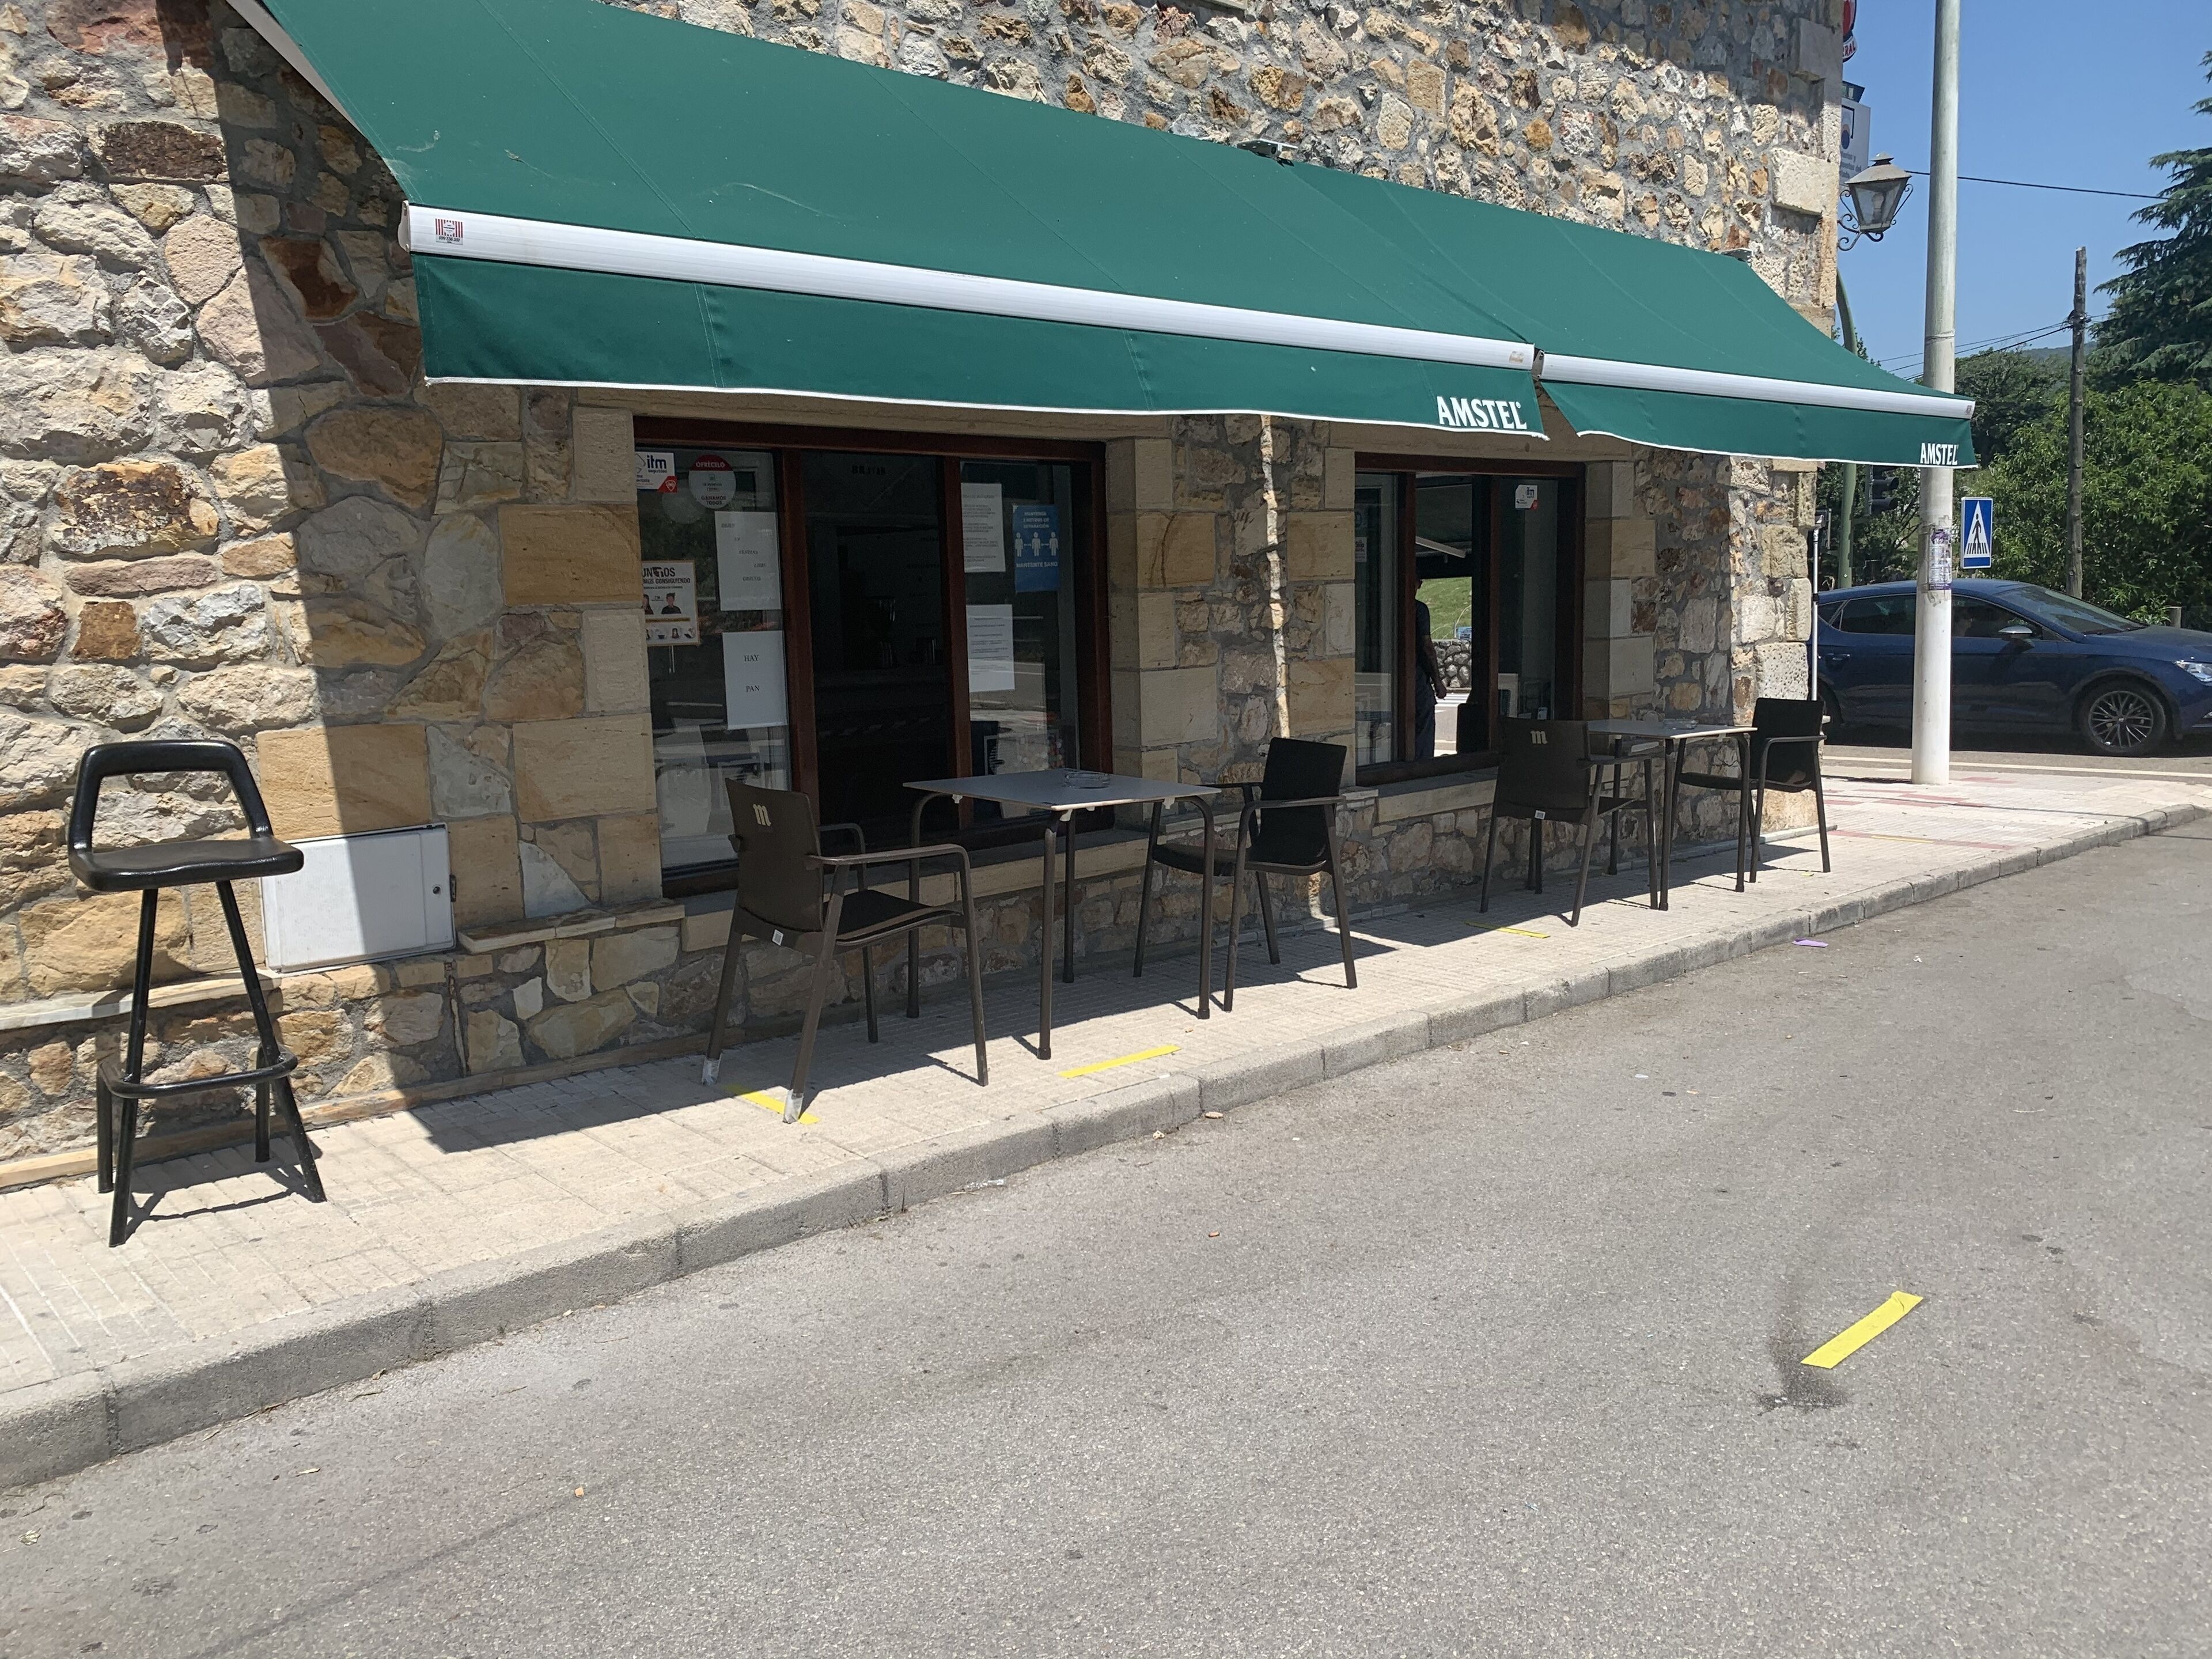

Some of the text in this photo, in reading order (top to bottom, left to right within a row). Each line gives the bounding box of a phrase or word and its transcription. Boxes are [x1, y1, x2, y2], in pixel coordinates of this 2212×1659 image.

[1843, 40, 1856, 56] RAL
[1437, 396, 1527, 430] AMSTEL
[1920, 442, 1958, 465] AMSTEL
[647, 454, 666, 469] itm
[695, 460, 726, 468] OFRÉCELO
[746, 685, 760, 693] PAN
